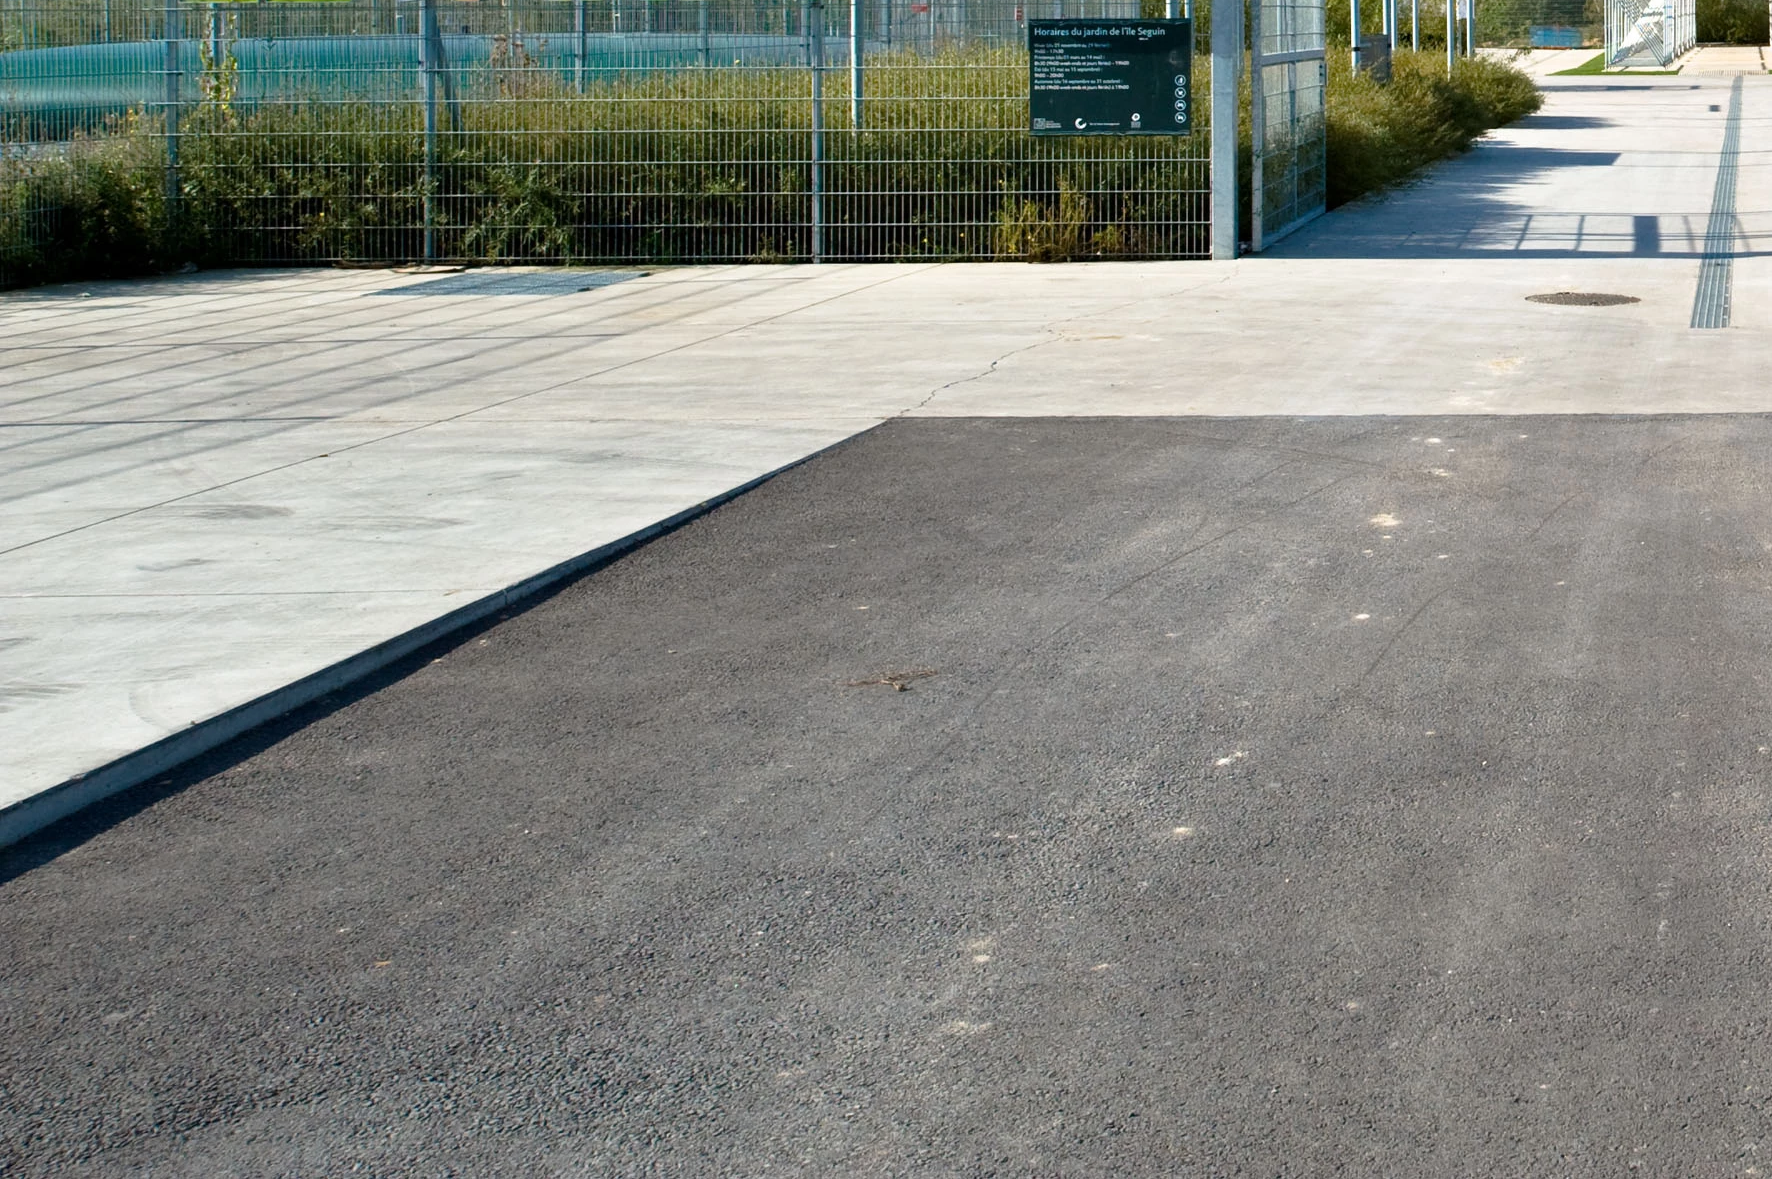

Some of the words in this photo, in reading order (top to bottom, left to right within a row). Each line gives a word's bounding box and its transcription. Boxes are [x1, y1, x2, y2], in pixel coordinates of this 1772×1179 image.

[1034, 27, 1069, 36] Horaires
[1071, 27, 1082, 36] du
[1083, 27, 1107, 38] jardin
[1109, 27, 1120, 36] de
[1137, 27, 1166, 38] Seguin
